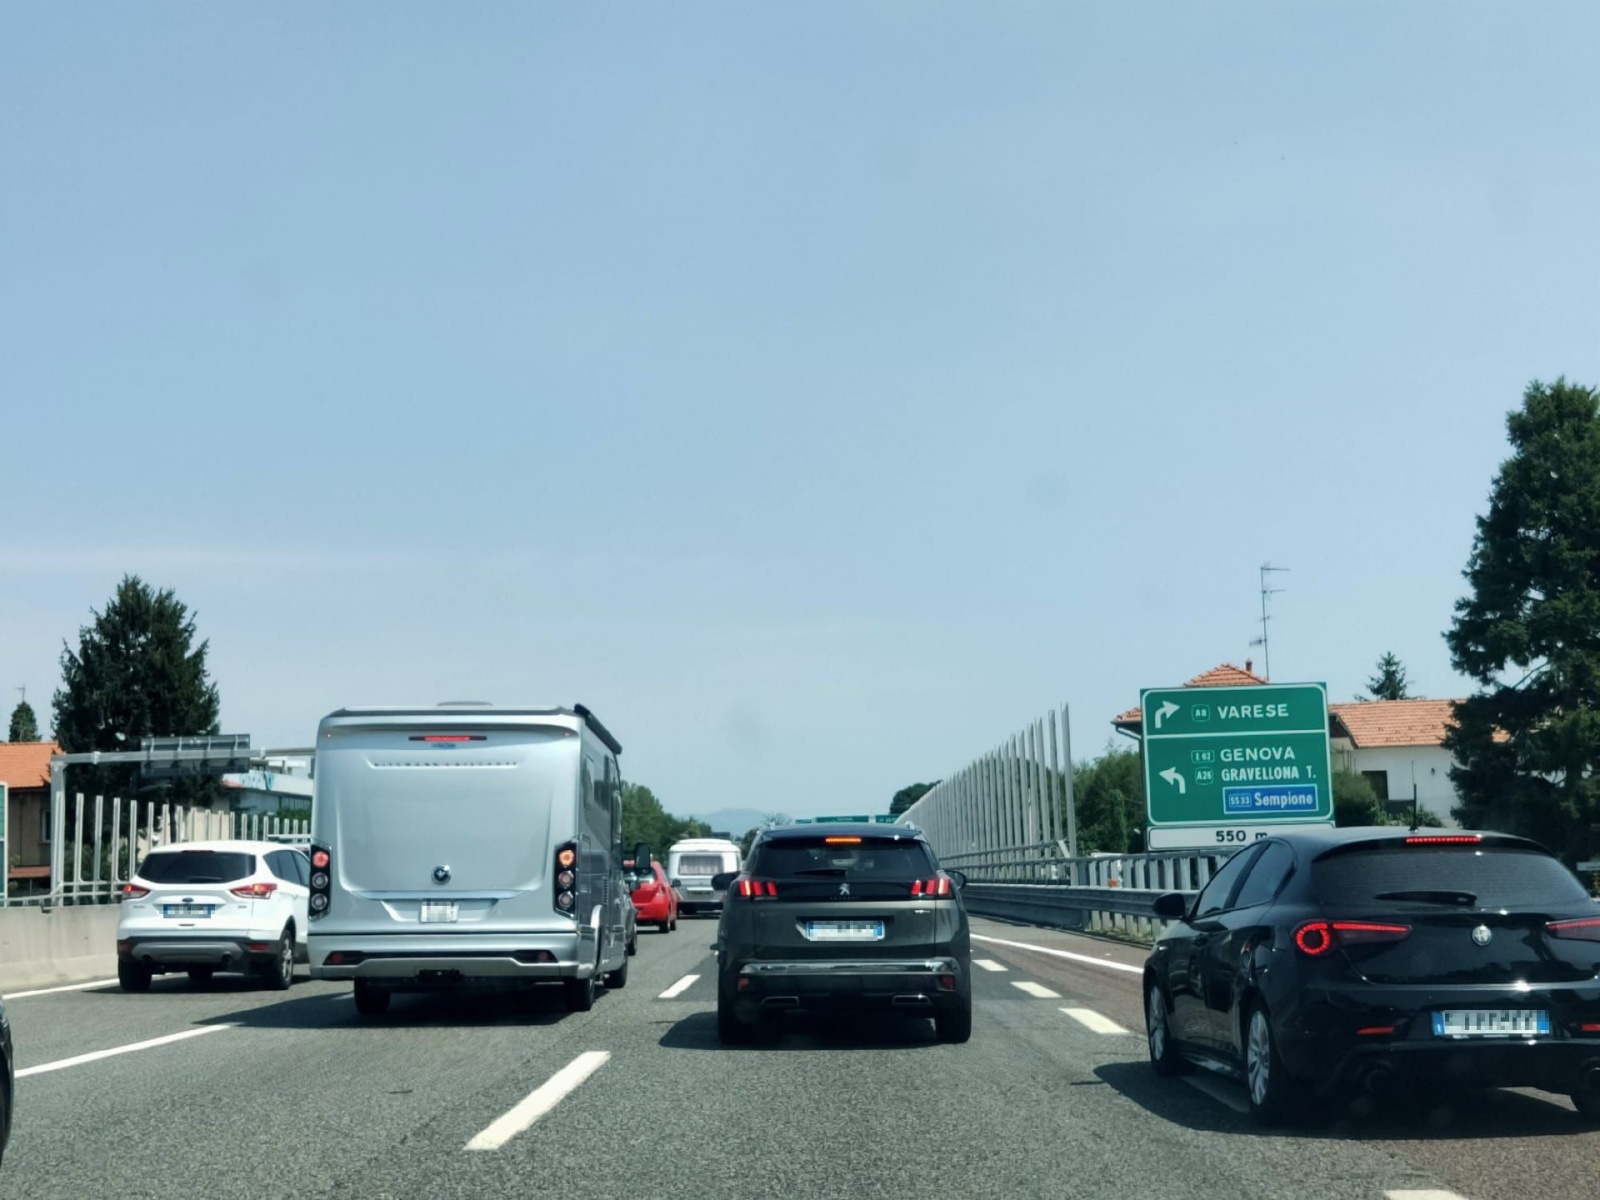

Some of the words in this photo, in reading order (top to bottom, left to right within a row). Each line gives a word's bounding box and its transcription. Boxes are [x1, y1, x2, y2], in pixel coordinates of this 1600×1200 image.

[1217, 703, 1289, 719] VARESE
[1220, 746, 1295, 762] GENOVA
[1196, 770, 1212, 780] A26
[1221, 766, 1299, 781] GRAVELLONA
[1306, 765, 1317, 779] T.
[1254, 791, 1313, 809] Sempione
[1215, 830, 1246, 842] 550
[1255, 832, 1267, 841] m
